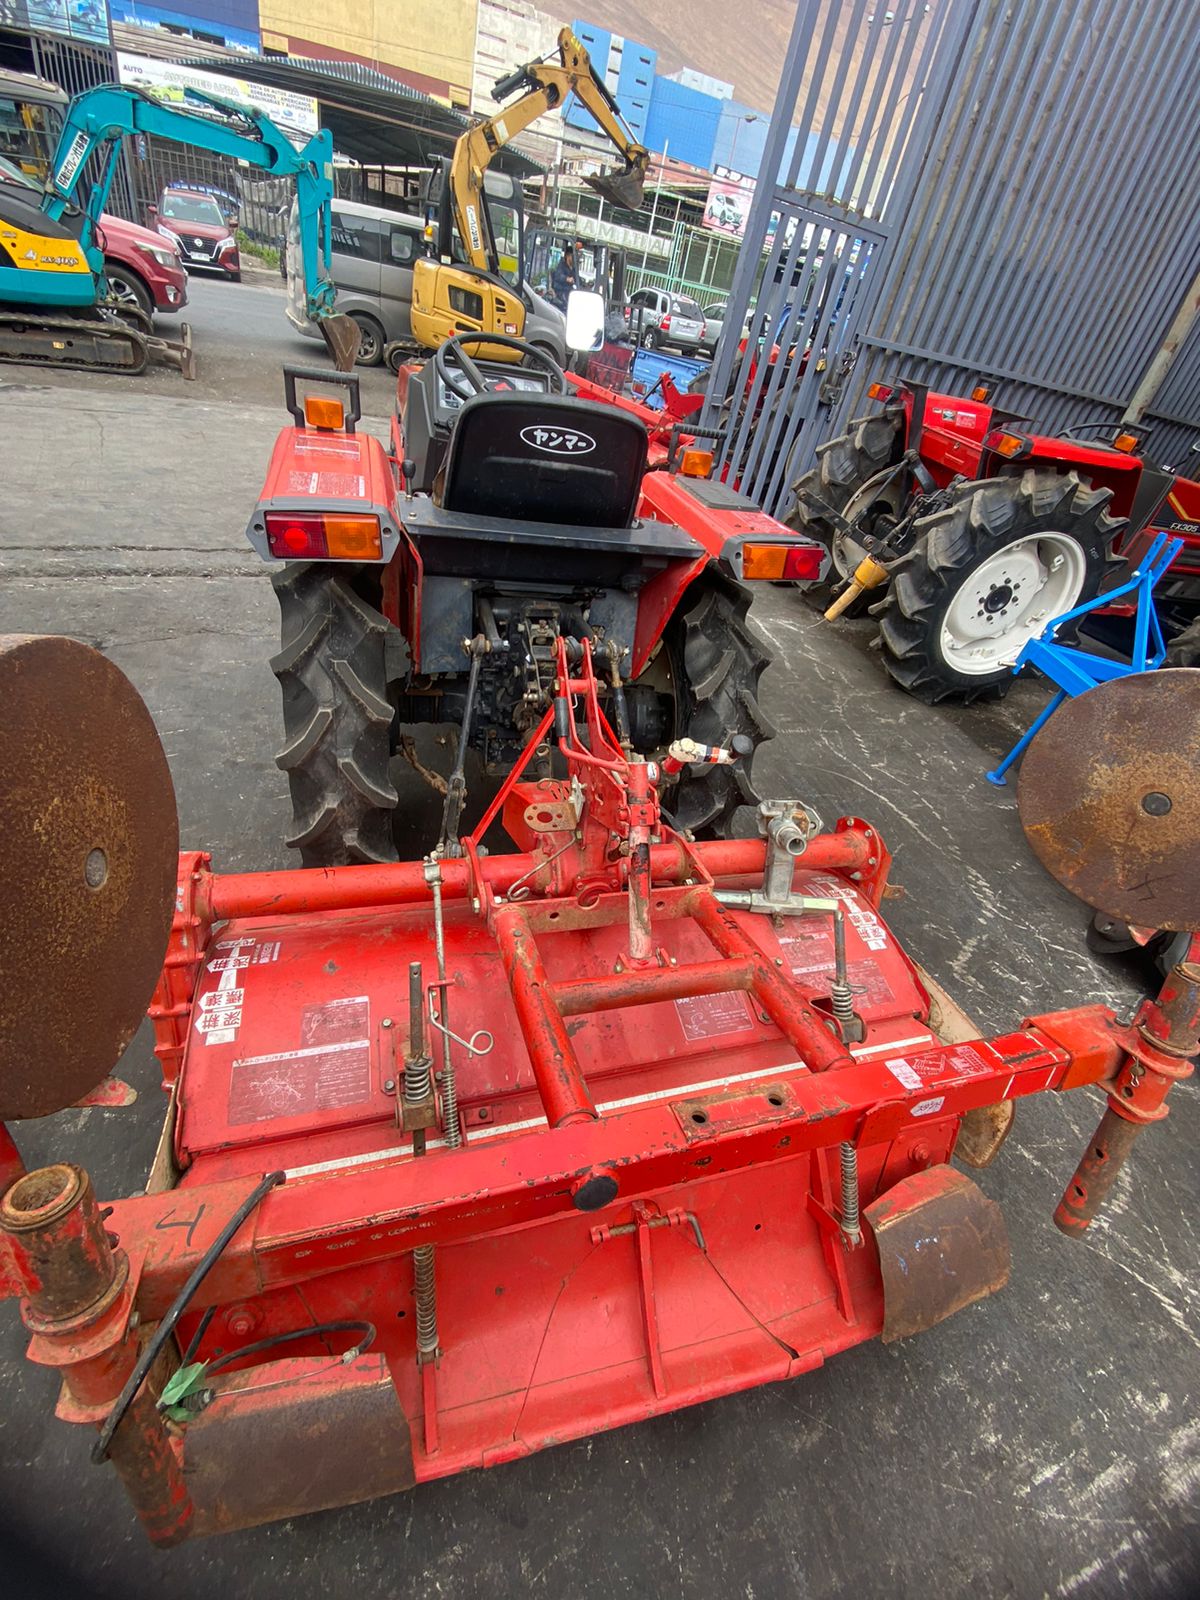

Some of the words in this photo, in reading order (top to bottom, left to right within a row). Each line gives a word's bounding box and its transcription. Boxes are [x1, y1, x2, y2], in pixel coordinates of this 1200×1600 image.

[123, 64, 143, 74] AUTO
[533, 428, 587, 450] ヤンマー
[1170, 522, 1199, 532] FX305
[202, 1010, 241, 1030] 深耕
[156, 1203, 206, 1248] 4
